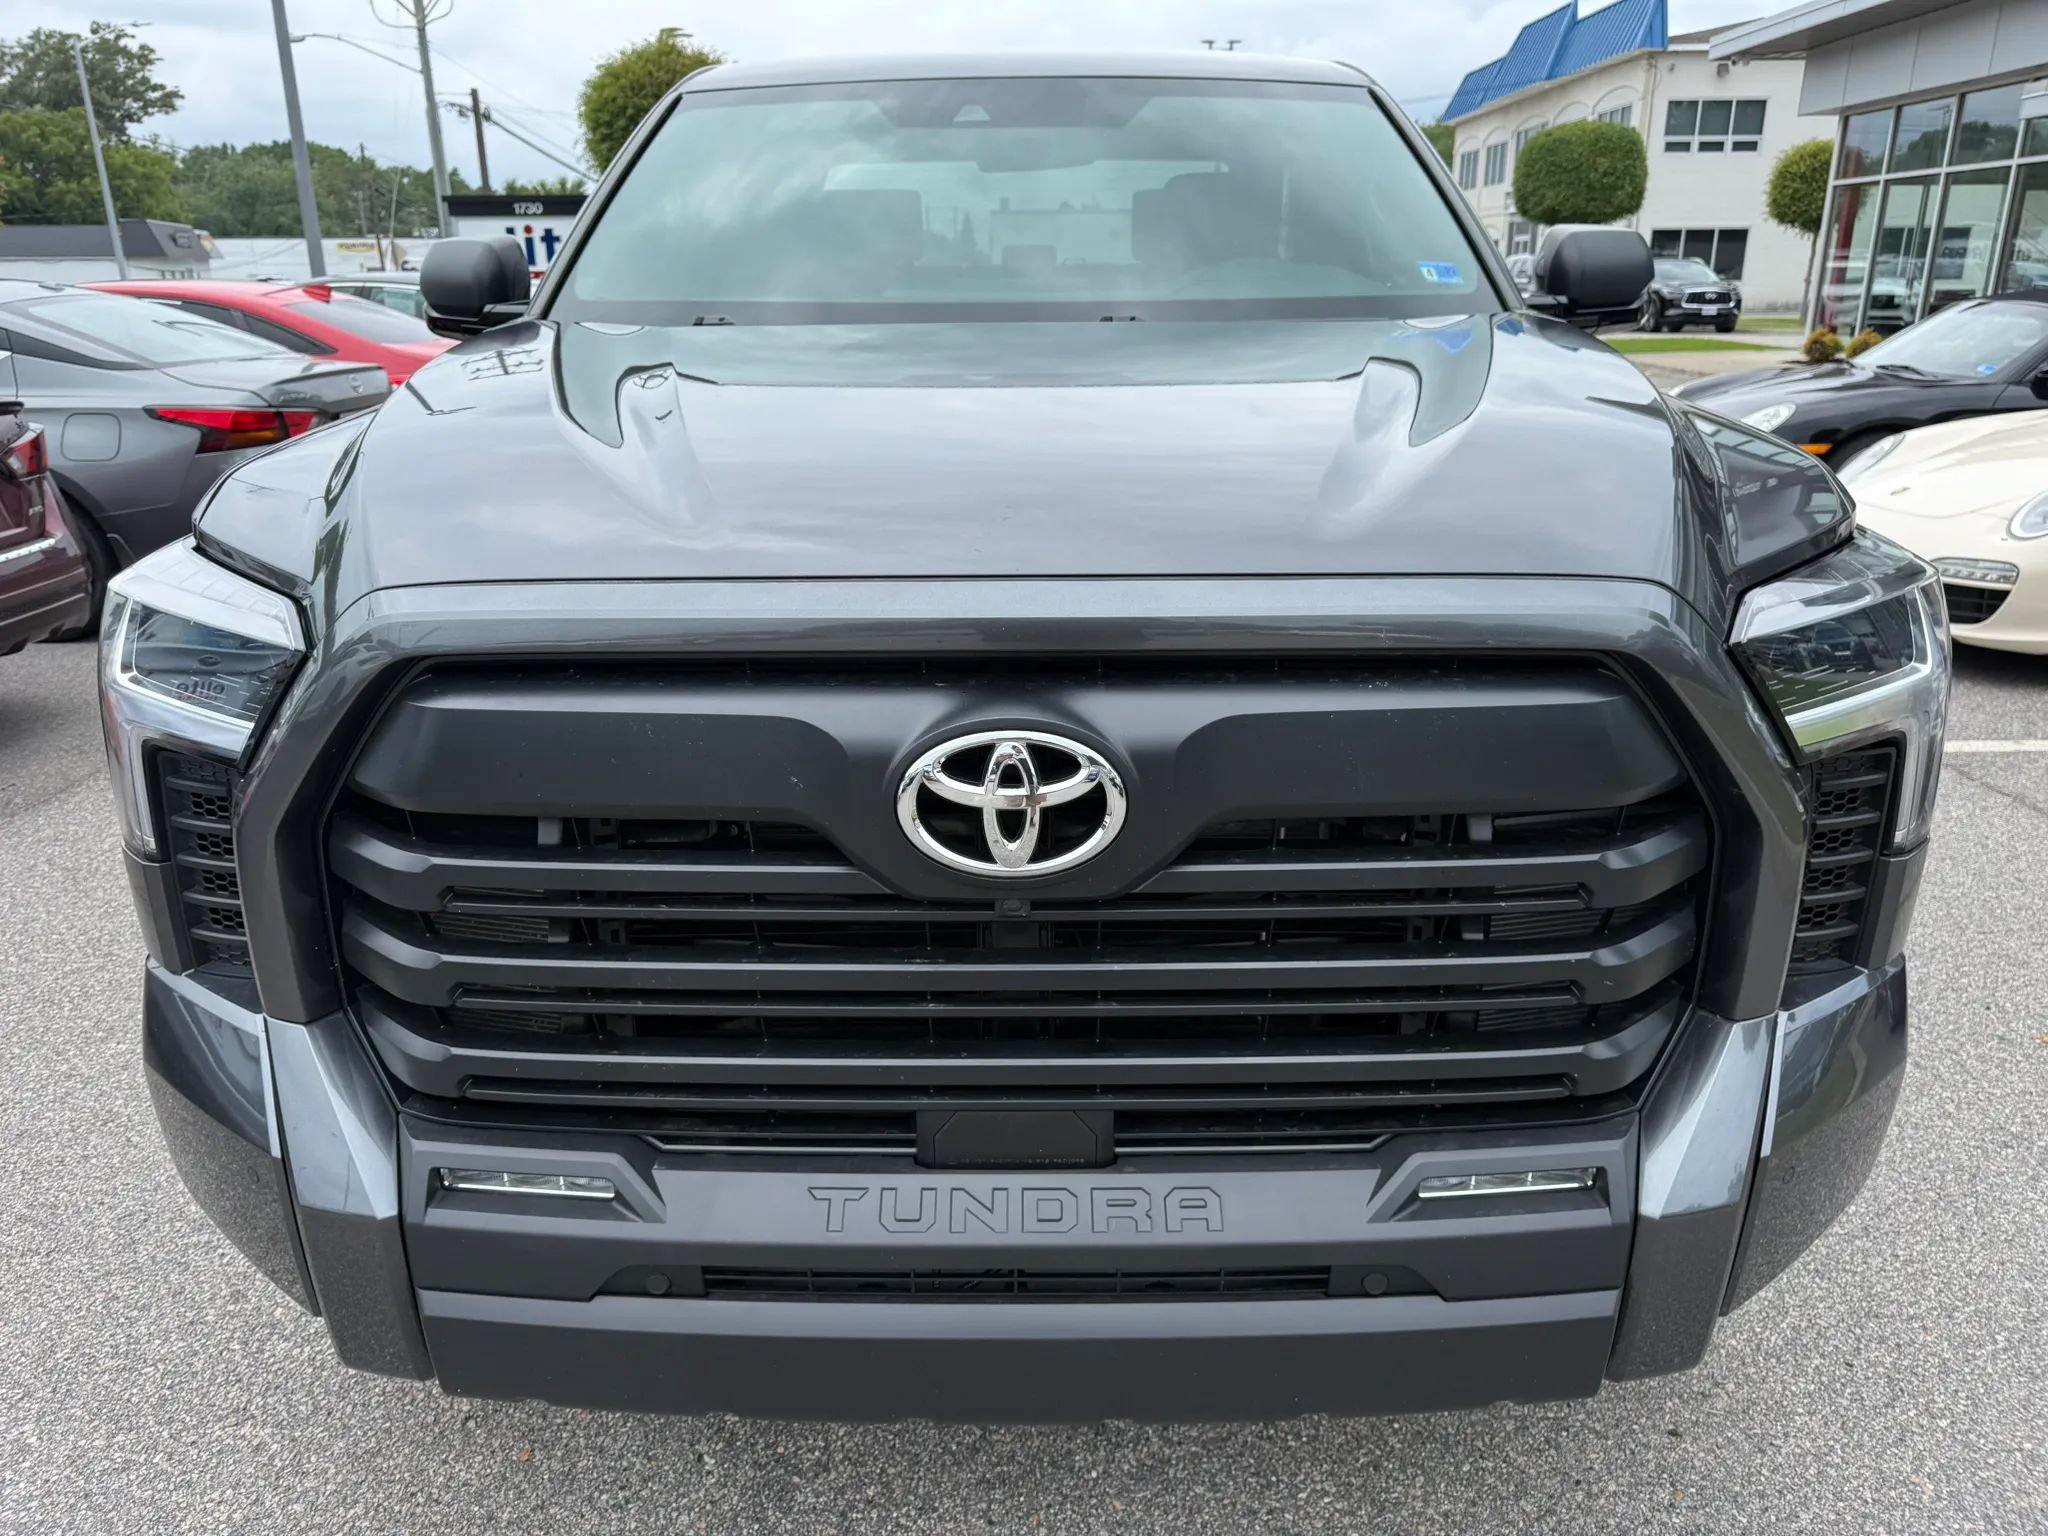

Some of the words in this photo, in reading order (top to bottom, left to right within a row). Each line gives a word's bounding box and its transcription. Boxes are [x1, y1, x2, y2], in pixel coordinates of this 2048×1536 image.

[512, 202, 544, 215] 1730
[505, 225, 560, 266] it
[807, 1186, 1225, 1234] TUNDRA
